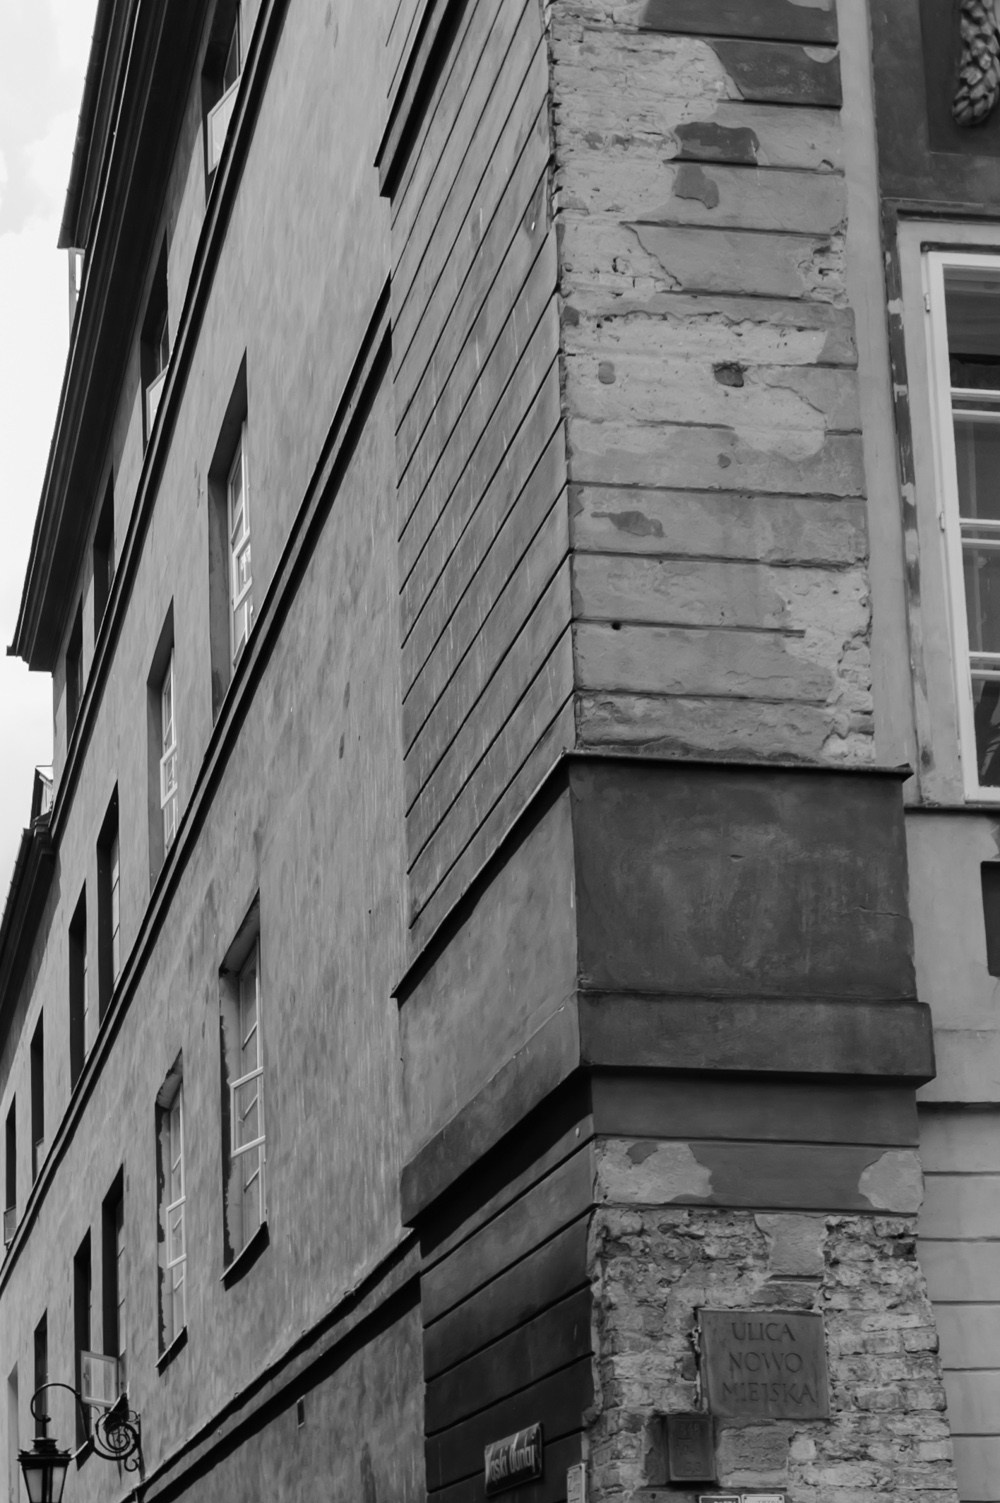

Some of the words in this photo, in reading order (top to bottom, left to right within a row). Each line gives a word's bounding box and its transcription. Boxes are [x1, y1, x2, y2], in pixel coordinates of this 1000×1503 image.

[731, 1322, 797, 1342] ULICA
[729, 1351, 804, 1373] NOWO
[721, 1382, 818, 1405] MIEJSKA
